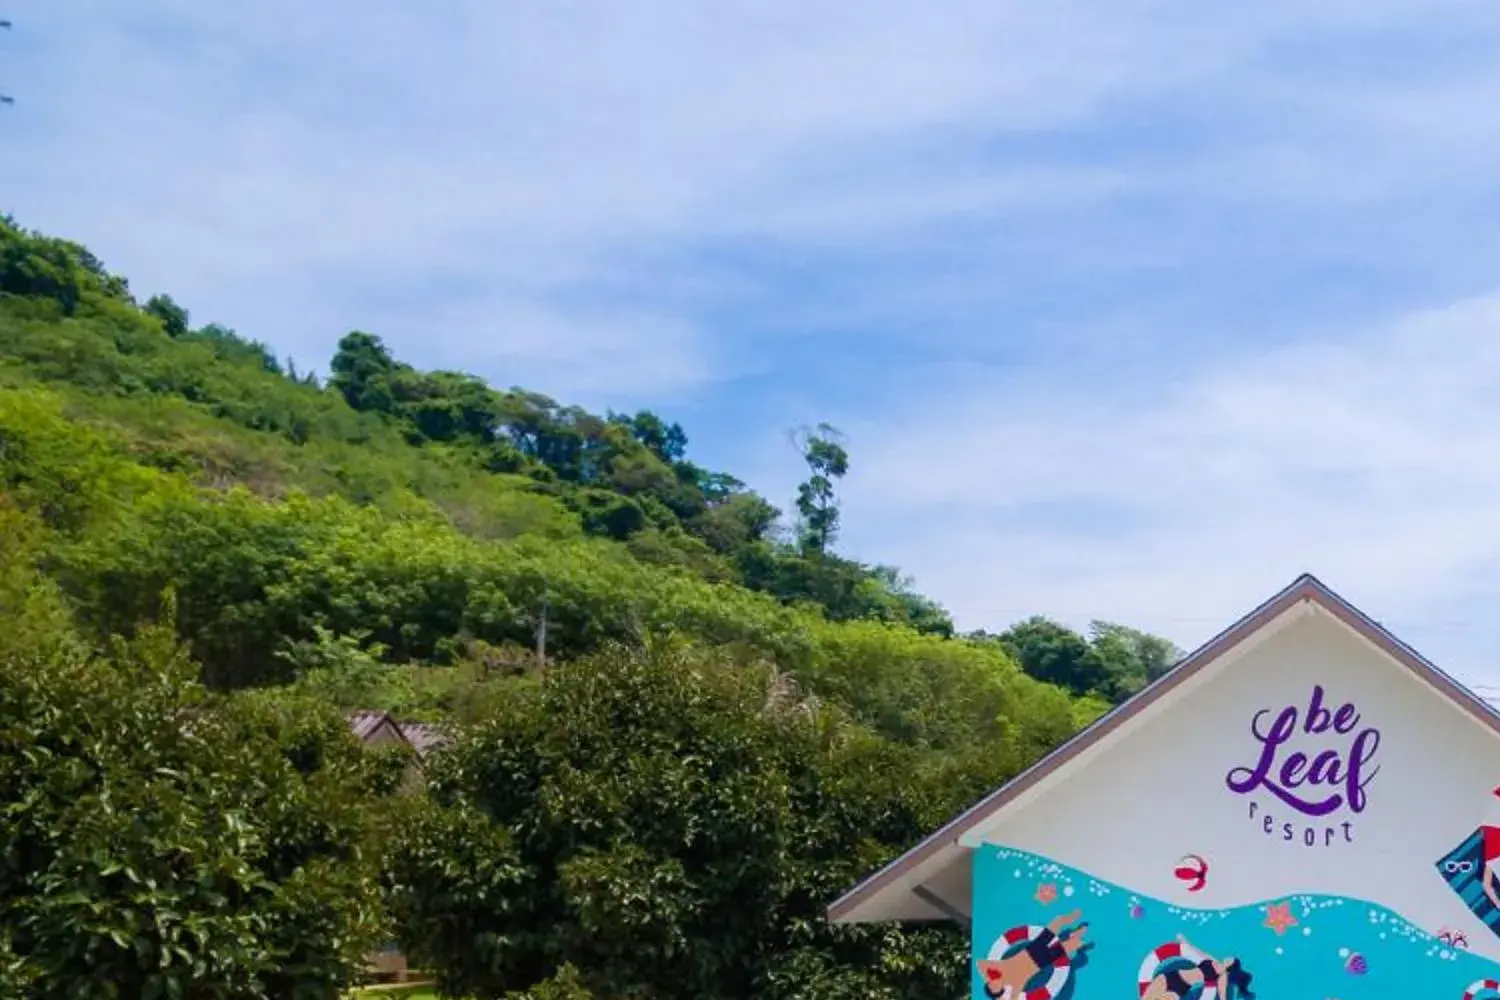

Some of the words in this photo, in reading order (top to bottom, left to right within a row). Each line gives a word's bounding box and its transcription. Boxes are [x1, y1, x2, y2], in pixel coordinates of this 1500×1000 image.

[1303, 685, 1361, 734] be
[1225, 705, 1381, 816] Leaf
[1249, 801, 1353, 847] resort
